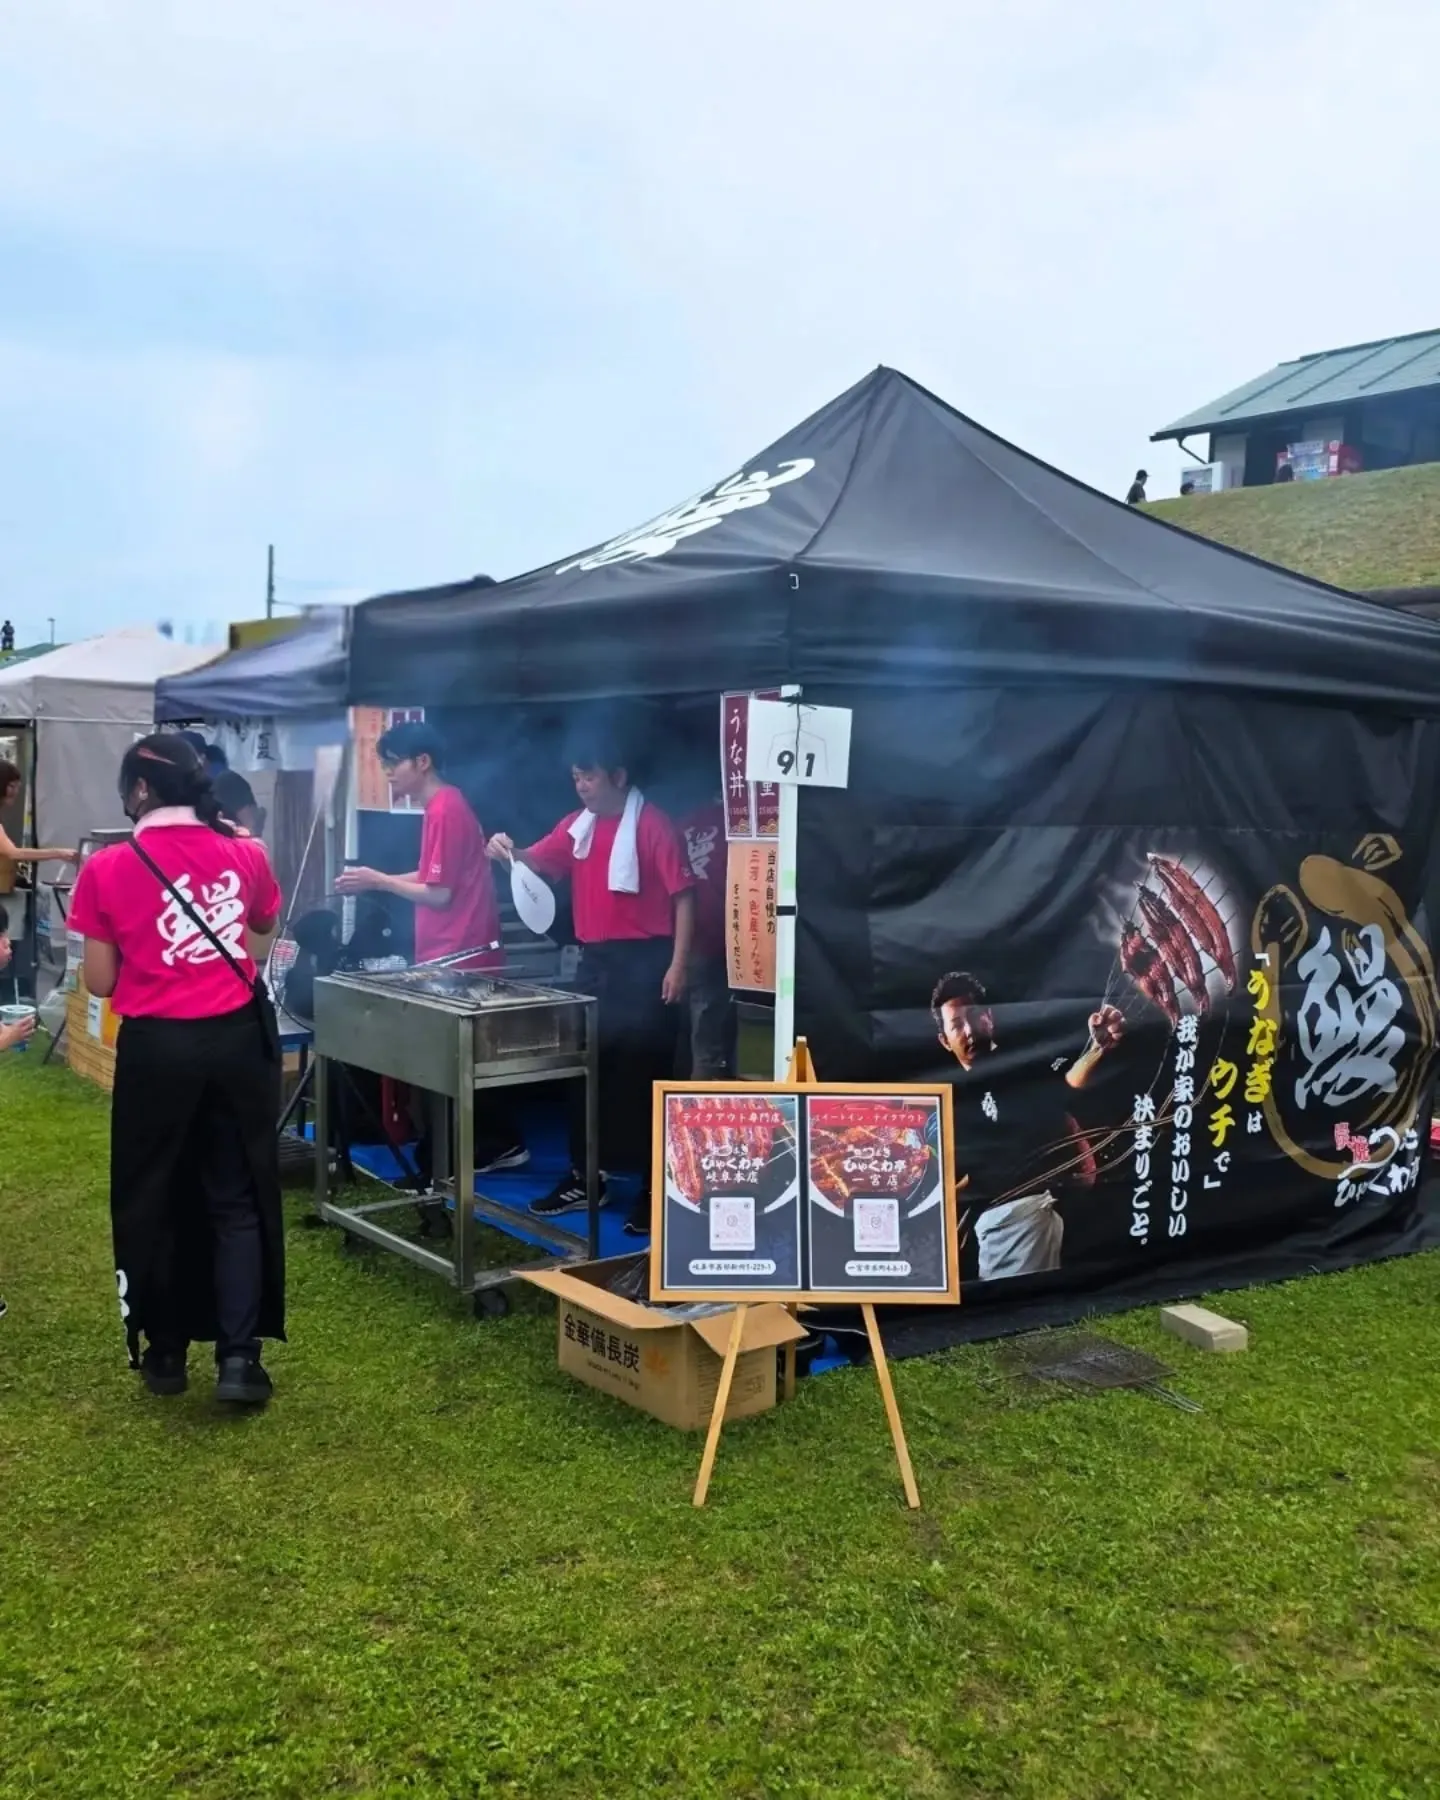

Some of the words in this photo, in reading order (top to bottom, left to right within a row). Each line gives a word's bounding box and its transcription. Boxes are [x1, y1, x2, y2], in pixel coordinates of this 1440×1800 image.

[728, 708, 747, 798] うな丼
[776, 750, 817, 779] 91
[765, 850, 777, 935] 当店自慢の
[682, 1111, 781, 1124] テイクアウト専門店
[1168, 1015, 1199, 1238] 我が家のおいしい
[701, 1156, 765, 1170] ひゃくわ亭
[706, 1171, 759, 1184] 岐阜本店
[841, 1159, 906, 1172] ひゃくわ亭
[1129, 1094, 1157, 1247] 決まりごと。
[851, 1173, 898, 1186] 一宮店
[563, 1313, 641, 1374] 金華備長炭
